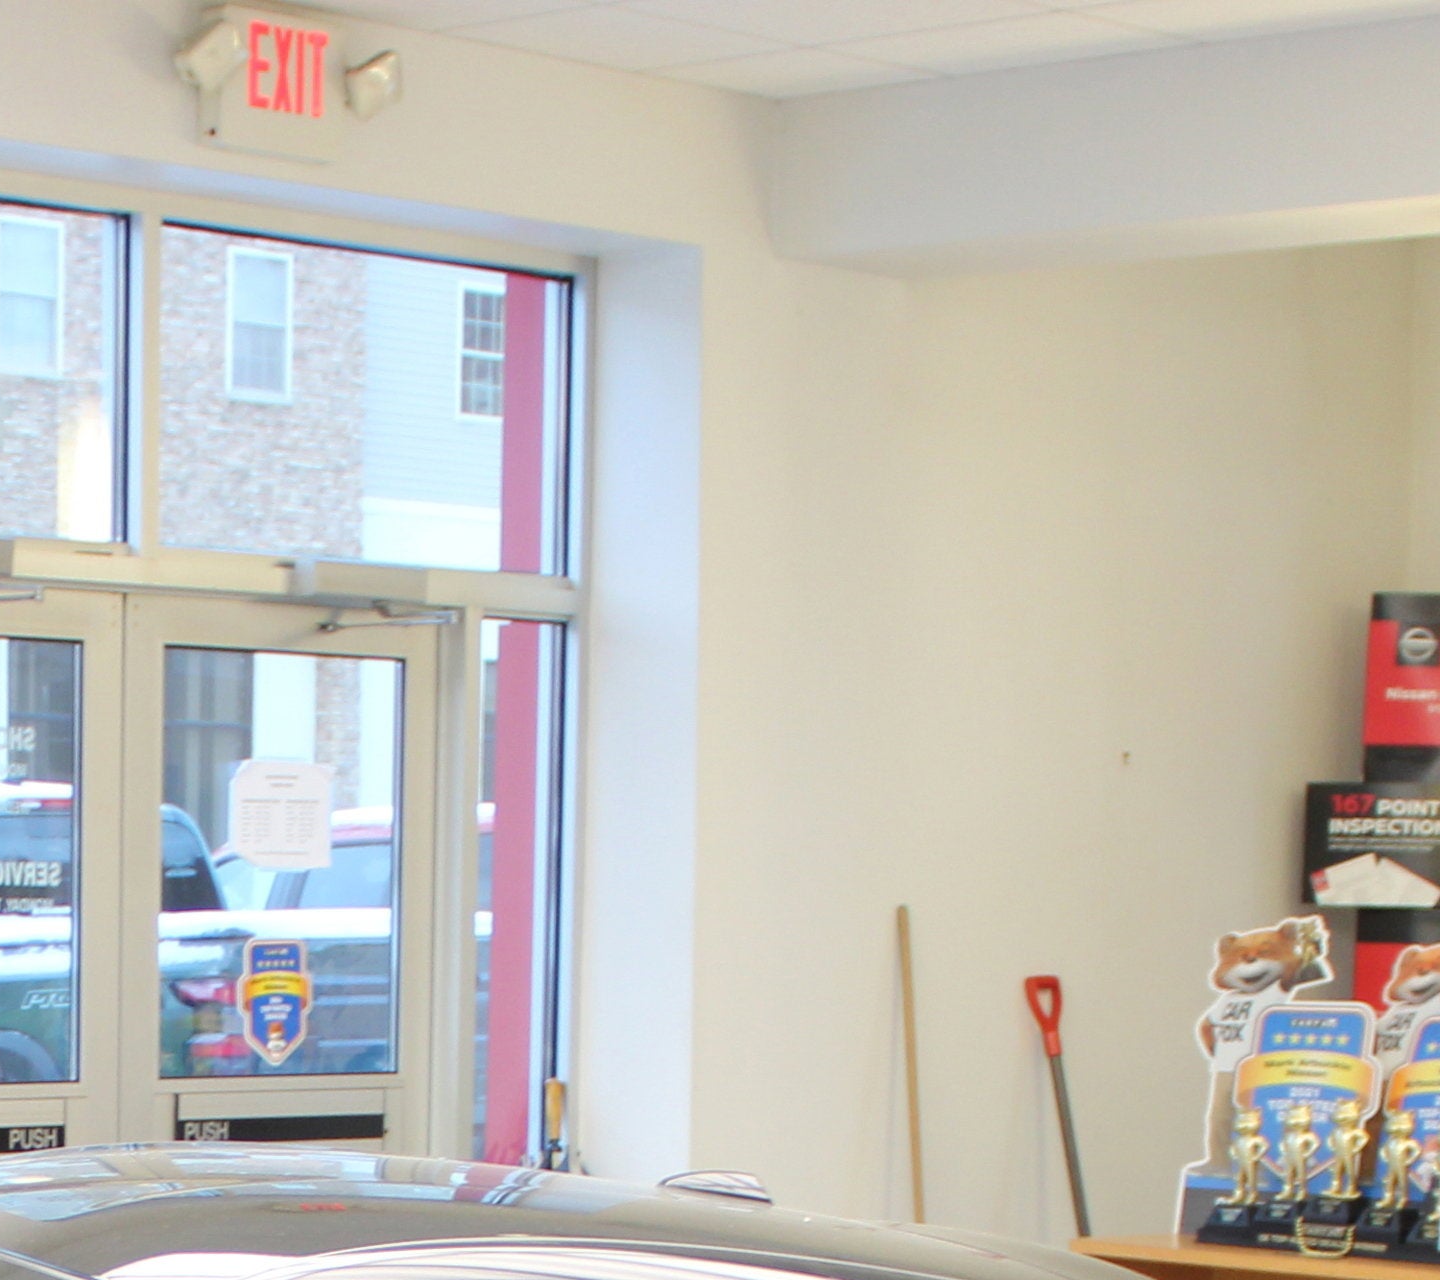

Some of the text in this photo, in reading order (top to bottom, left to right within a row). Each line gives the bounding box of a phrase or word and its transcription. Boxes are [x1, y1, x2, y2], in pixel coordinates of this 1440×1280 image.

[248, 20, 329, 118] EXIT
[1331, 794, 1376, 815] 167
[8, 1127, 58, 1150] PUSH
[184, 1121, 228, 1140] PUSH
